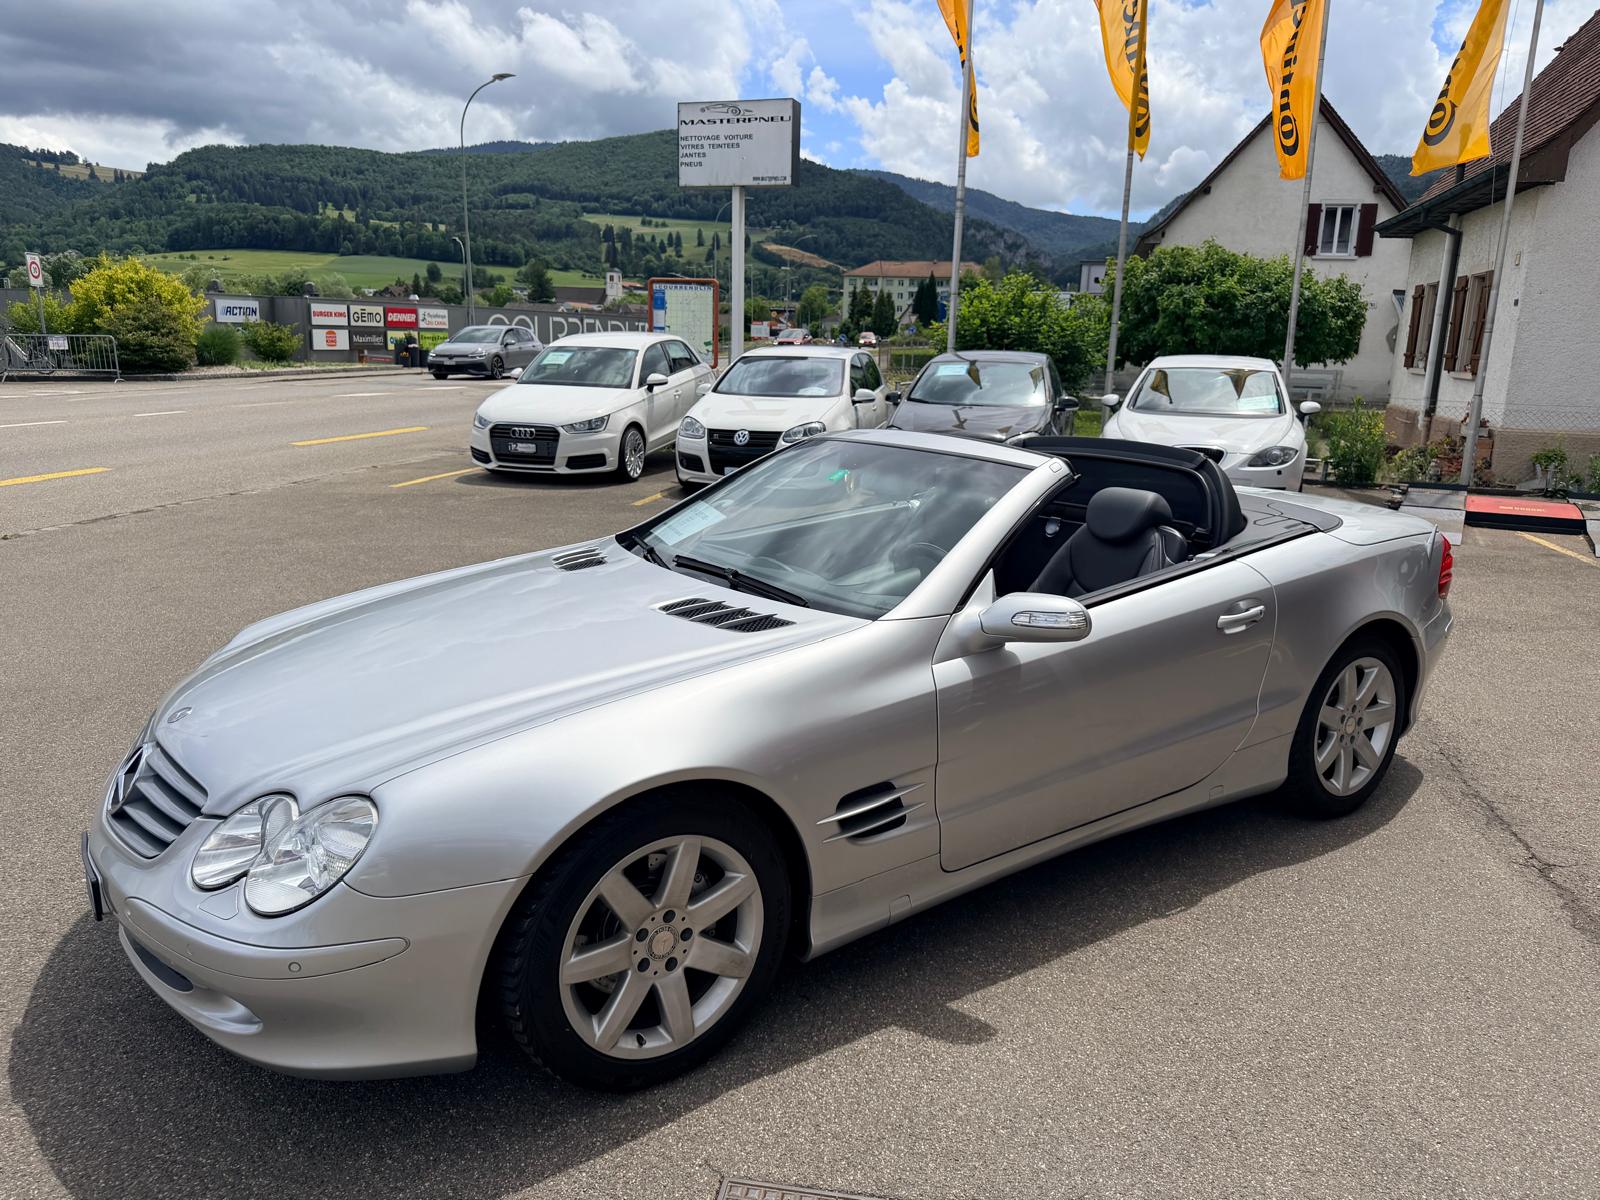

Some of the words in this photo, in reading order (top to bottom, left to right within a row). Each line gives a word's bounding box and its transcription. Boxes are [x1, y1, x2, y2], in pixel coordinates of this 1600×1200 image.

[680, 115, 792, 126] MASTERPNEU
[680, 134, 721, 142] NETTOYAGE
[723, 133, 754, 141] VOITURE
[225, 306, 257, 317] ACTION
[387, 312, 417, 322] DENNER
